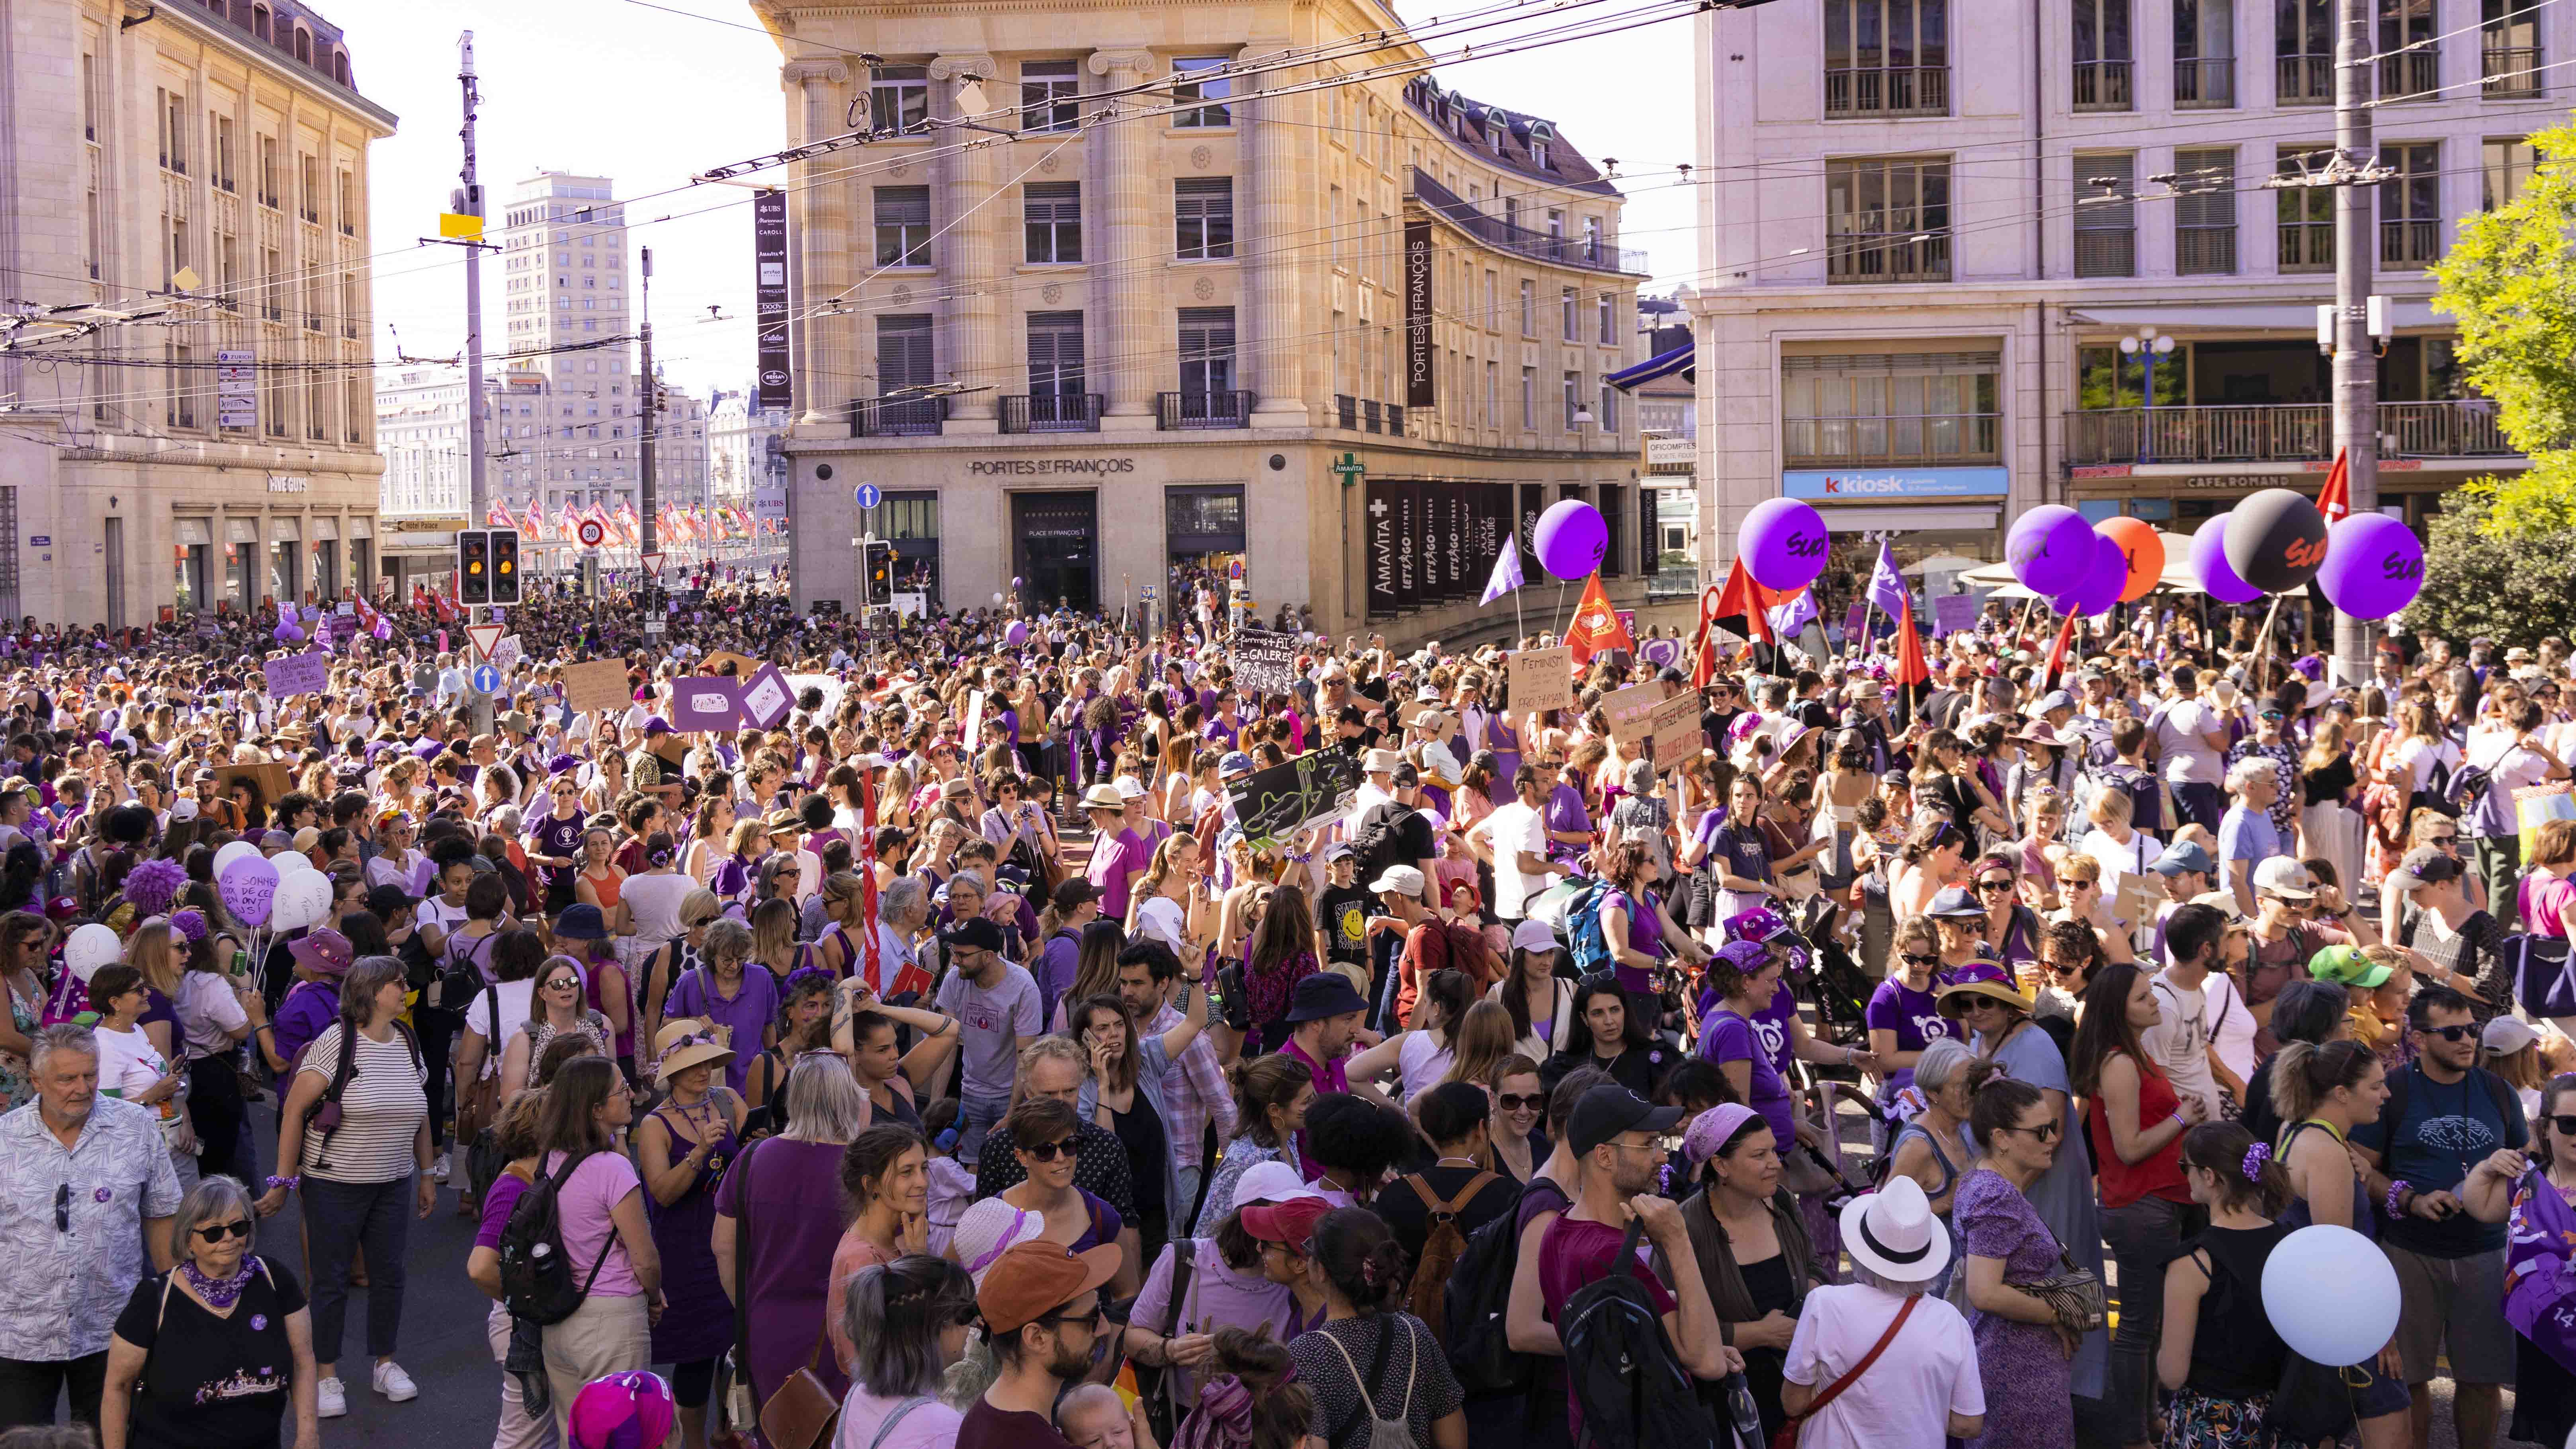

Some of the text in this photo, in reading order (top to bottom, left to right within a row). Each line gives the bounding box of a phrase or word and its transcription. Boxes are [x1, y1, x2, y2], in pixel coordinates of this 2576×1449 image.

[1414, 326, 1425, 381] PORTES
[973, 461, 1036, 475] PORTES
[1053, 458, 1134, 477] FRANÇOIS
[268, 476, 307, 493] FIVE GUYS
[1843, 475, 1904, 493] kiosk
[586, 529, 596, 538] 30
[1522, 655, 1563, 671] FEMINISM
[242, 876, 277, 887] SOMMES
